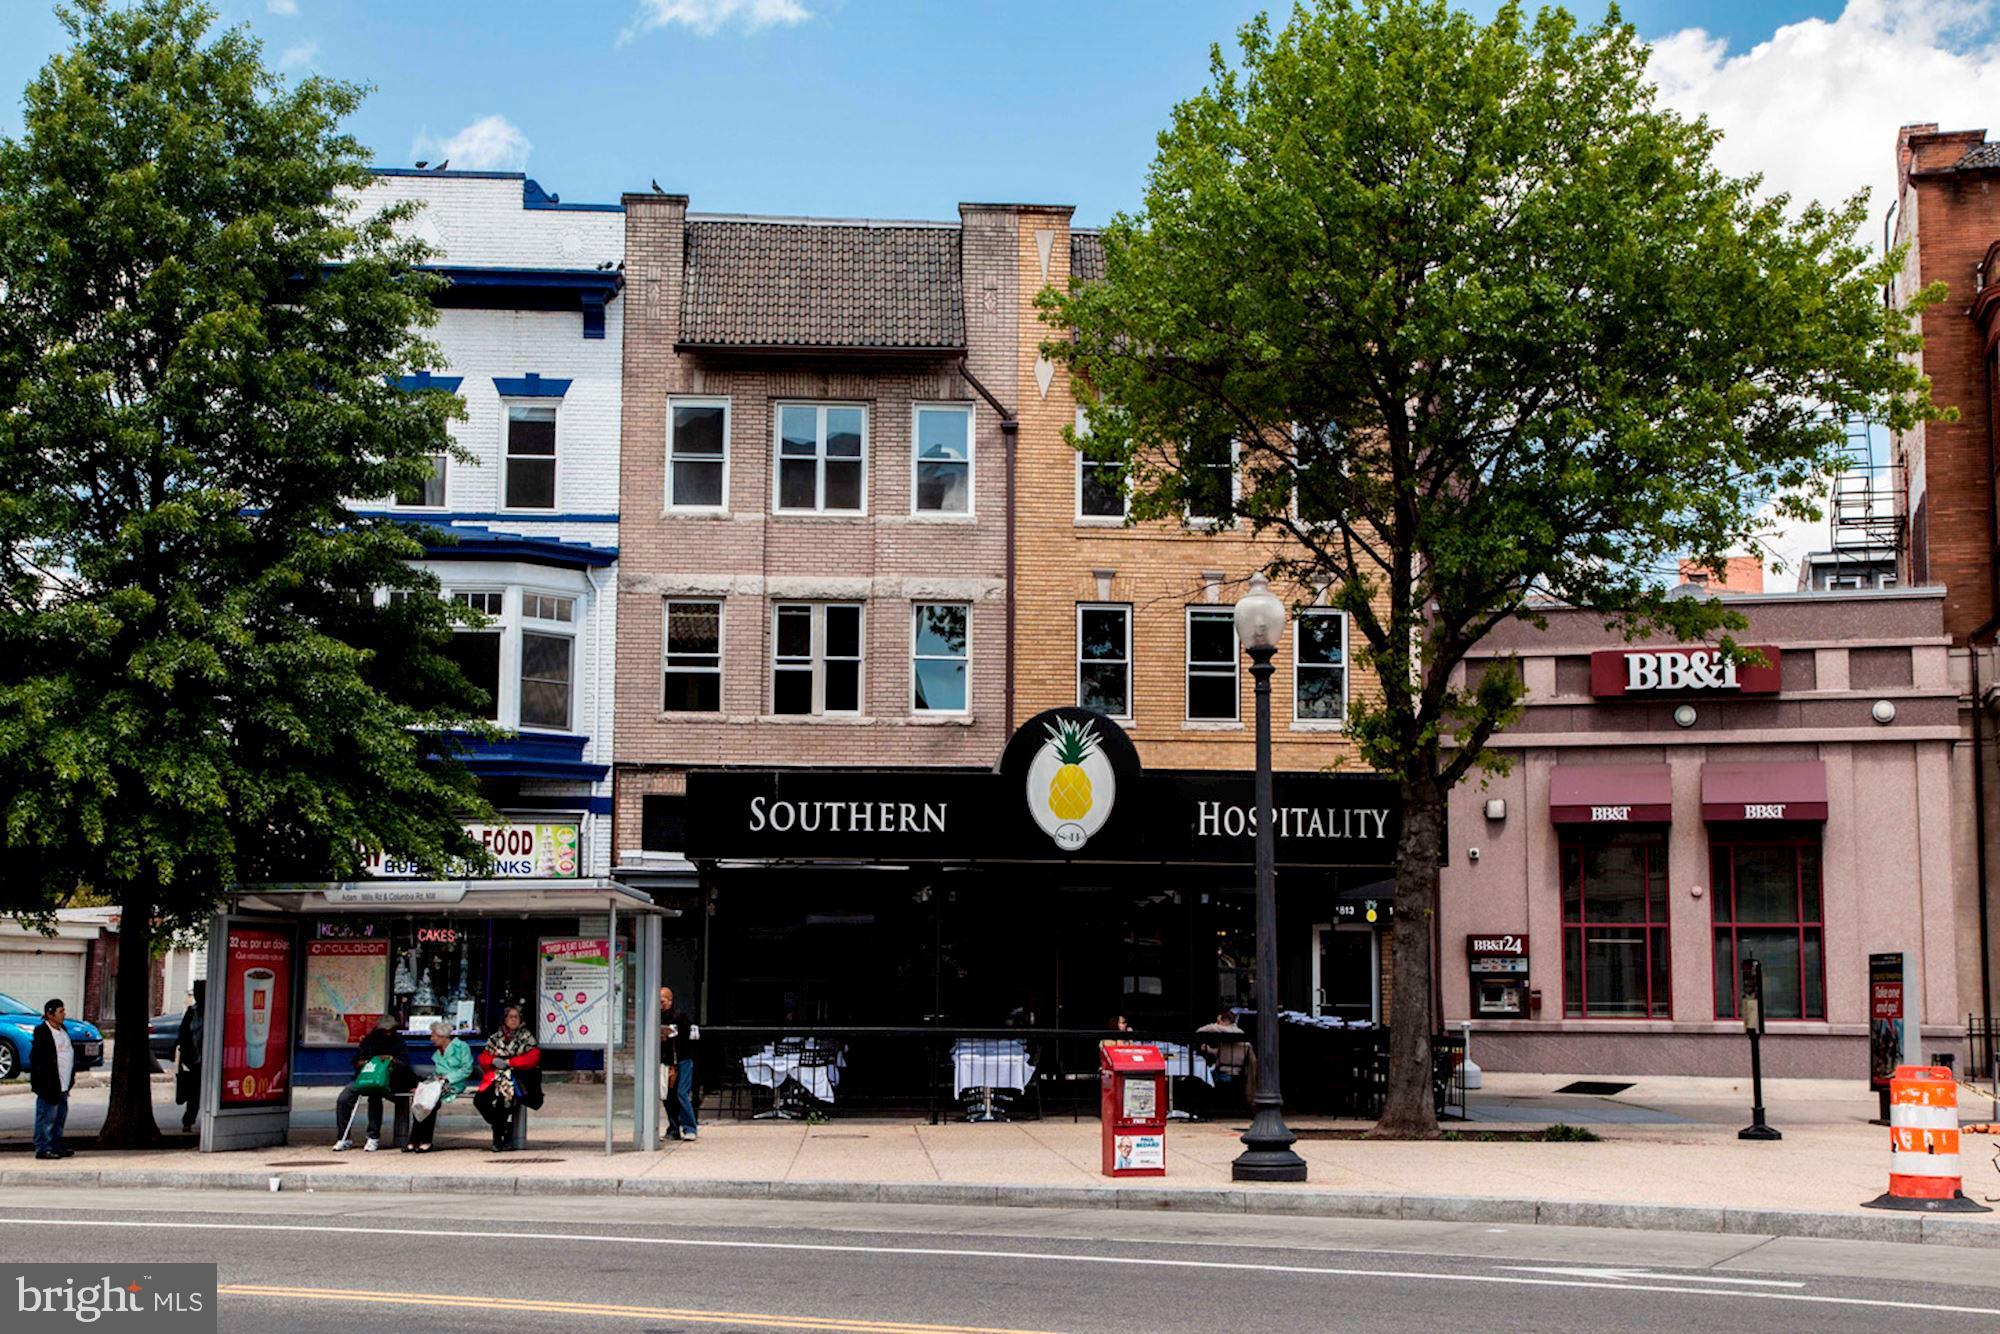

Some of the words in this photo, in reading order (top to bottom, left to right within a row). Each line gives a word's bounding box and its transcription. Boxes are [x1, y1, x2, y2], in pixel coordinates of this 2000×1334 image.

[750, 797, 947, 832] SOUTHERN
[1591, 806, 1631, 821] BB&T
[1744, 804, 1785, 819] BB&T
[482, 830, 533, 856] FOOD
[229, 936, 240, 948] 32
[417, 928, 456, 942] CAKES
[578, 940, 598, 950] LOCAL
